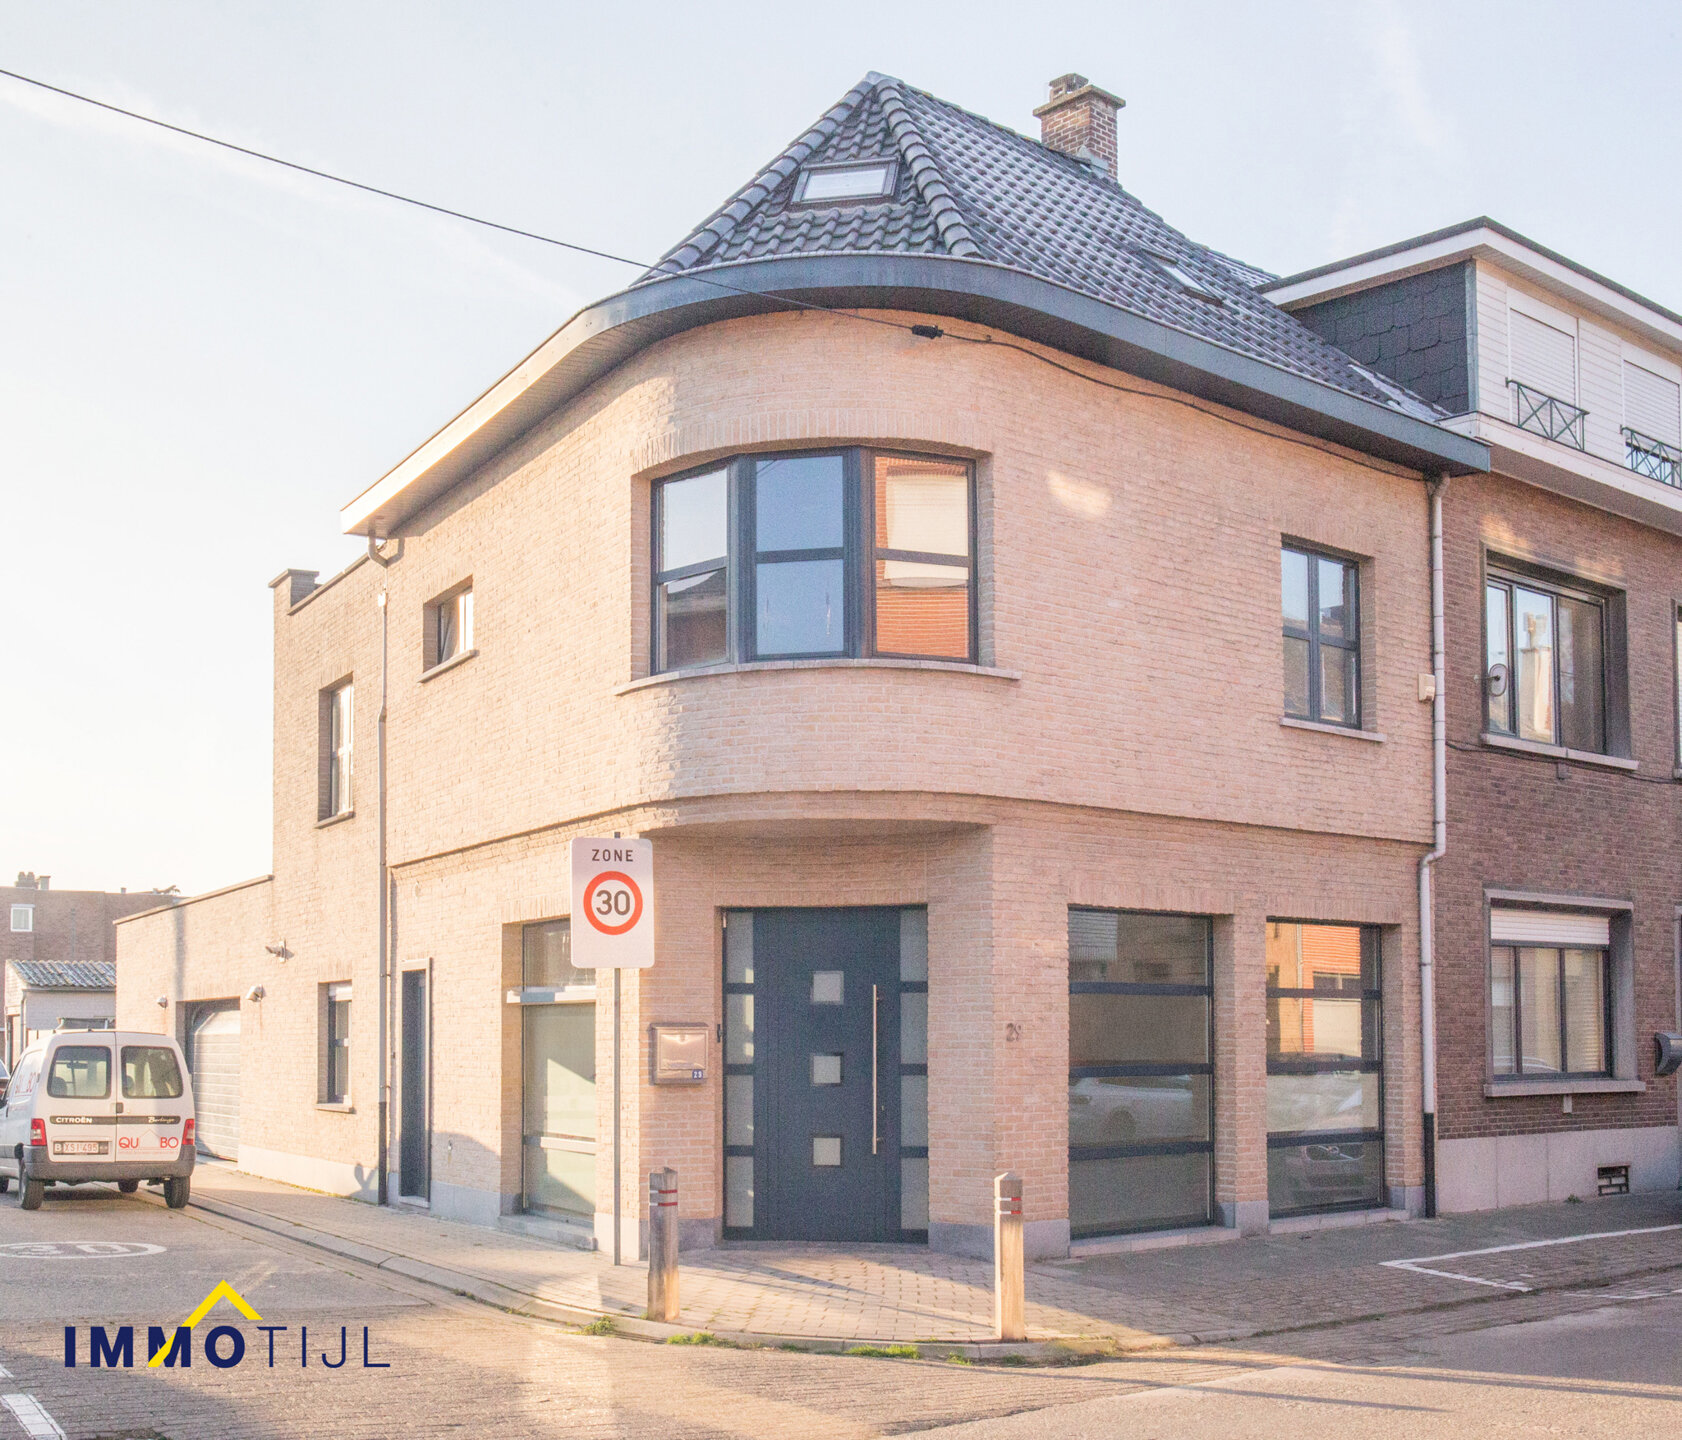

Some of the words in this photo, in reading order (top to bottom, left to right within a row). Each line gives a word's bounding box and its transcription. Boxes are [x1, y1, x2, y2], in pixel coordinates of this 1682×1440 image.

[592, 848, 634, 862] ZONE
[596, 889, 631, 916] 30
[55, 1116, 93, 1124] CITROËN
[54, 1143, 62, 1152] B
[118, 1136, 139, 1149] QU
[160, 1136, 179, 1149] BO
